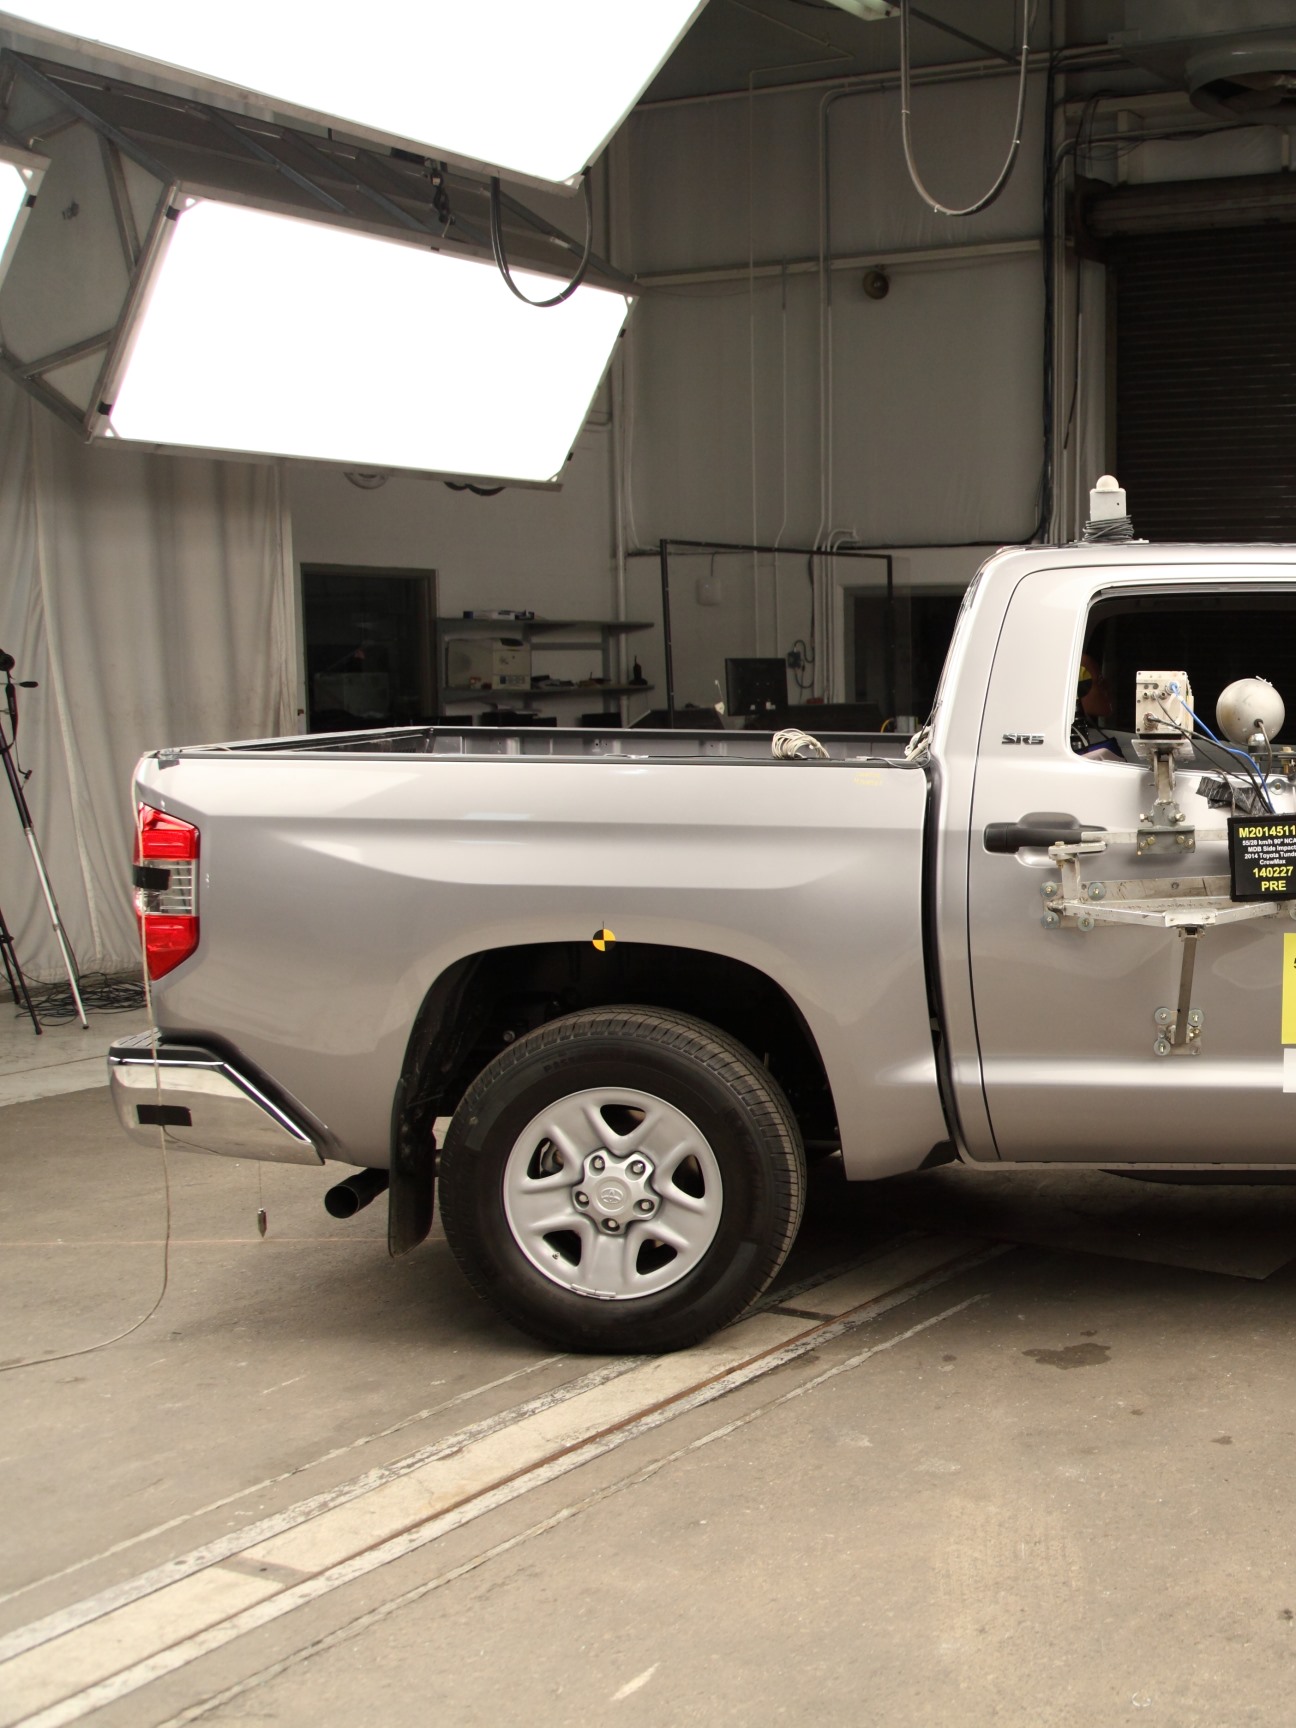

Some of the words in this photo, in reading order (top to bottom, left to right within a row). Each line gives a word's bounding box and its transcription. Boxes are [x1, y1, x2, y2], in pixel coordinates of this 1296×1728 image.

[1001, 733, 1045, 745] SR5
[1253, 866, 1293, 878] 140227
[1261, 881, 1286, 891] PRE
